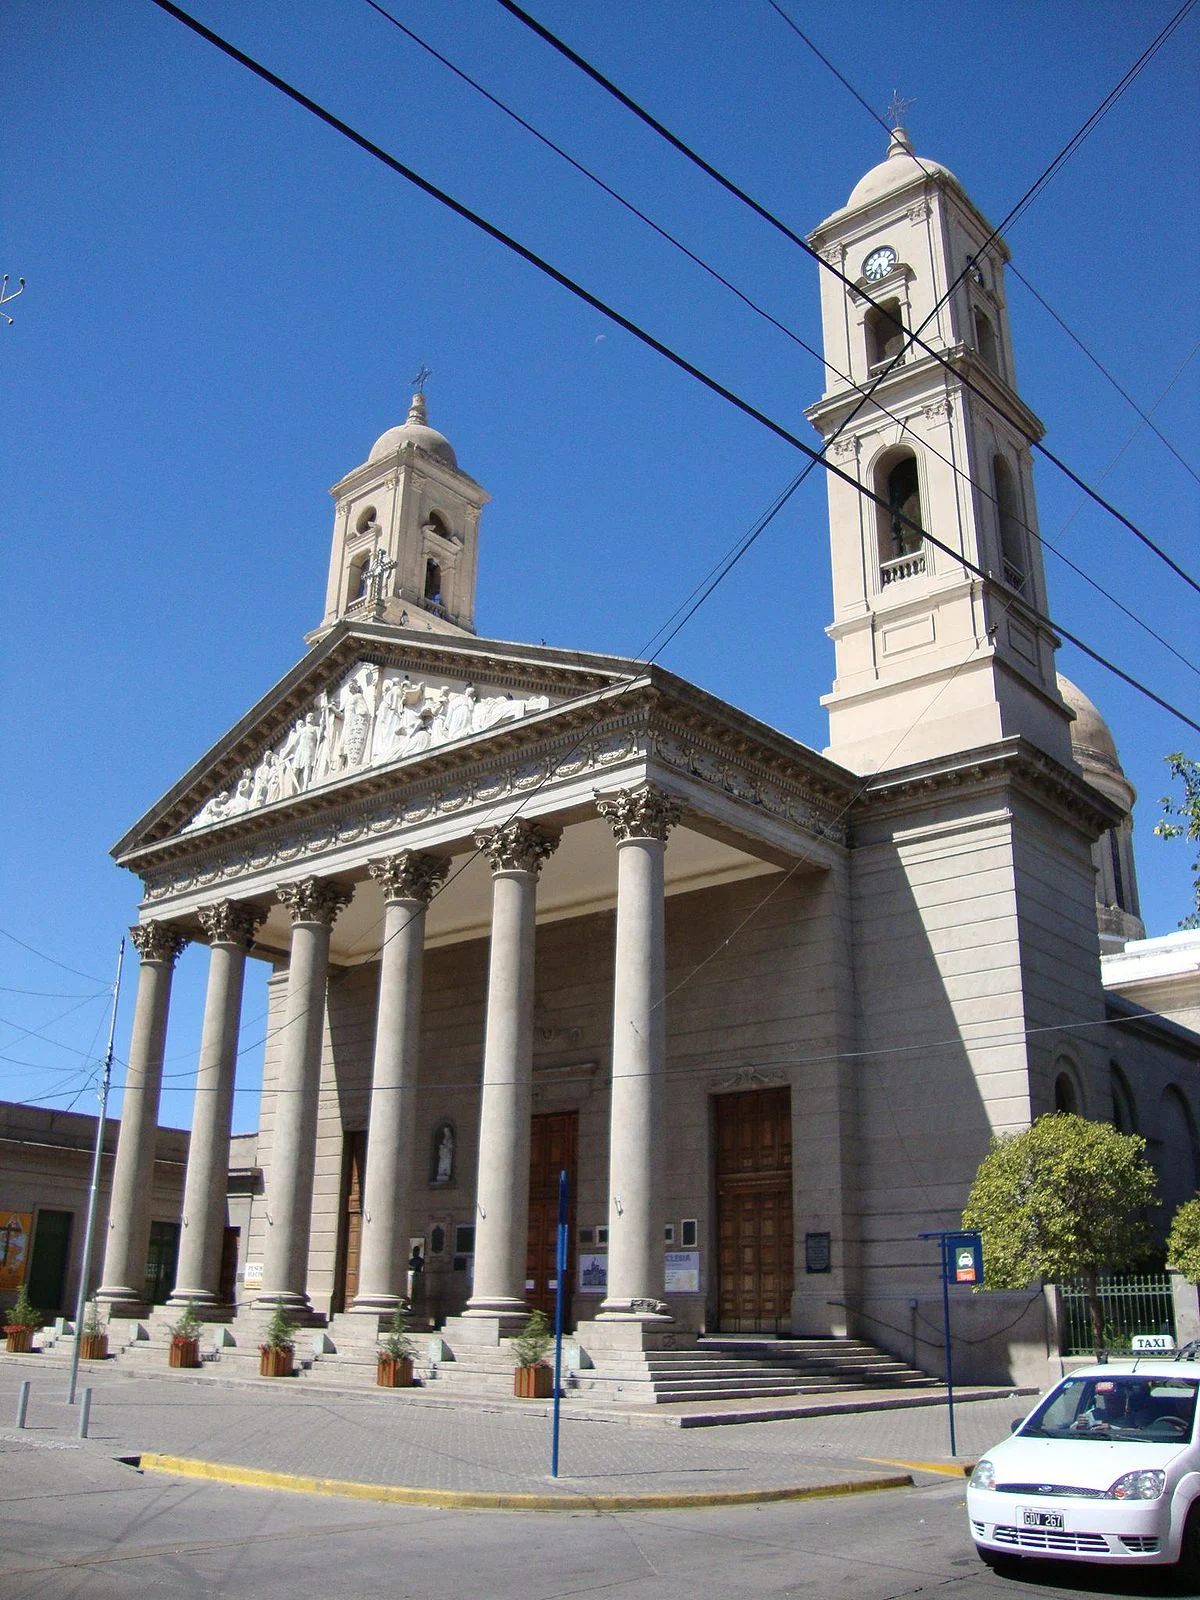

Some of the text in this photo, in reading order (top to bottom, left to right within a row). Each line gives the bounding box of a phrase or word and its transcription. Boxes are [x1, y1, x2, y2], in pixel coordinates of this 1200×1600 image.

[1137, 1339, 1166, 1348] TAXI
[1024, 1512, 1061, 1527] GDV 267
